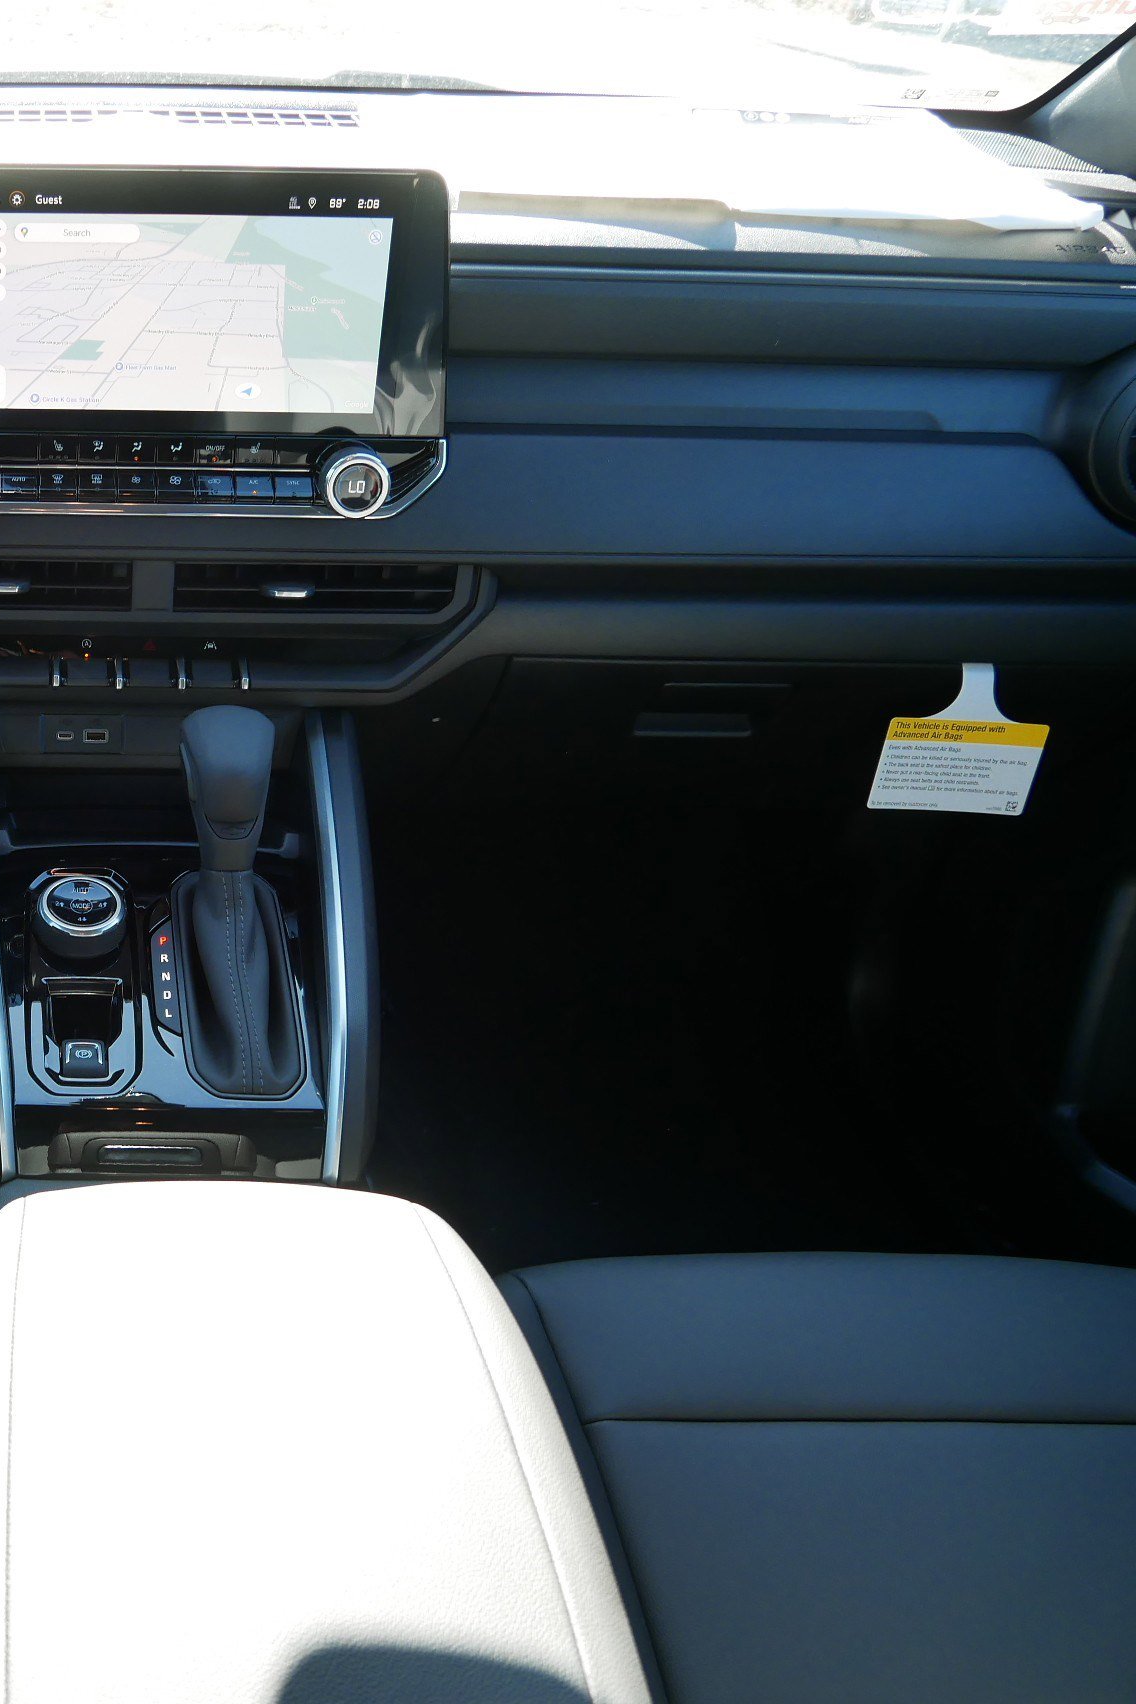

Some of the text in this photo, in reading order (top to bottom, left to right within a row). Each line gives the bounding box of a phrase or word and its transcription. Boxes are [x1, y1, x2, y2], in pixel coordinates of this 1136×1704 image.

[35, 195, 63, 205] Guest
[357, 199, 380, 209] 2:08
[63, 229, 91, 237] Search
[344, 400, 369, 409] Google
[348, 480, 366, 494] LO
[896, 721, 912, 729] This
[913, 722, 940, 730] Vehicle
[951, 723, 988, 733] Equipped
[893, 730, 930, 739] Advanced
[944, 732, 963, 741] Bags
[159, 936, 167, 946] P
[160, 953, 169, 963] R
[161, 971, 171, 982] N
[163, 990, 172, 1000] D
[164, 1008, 173, 1018] L
